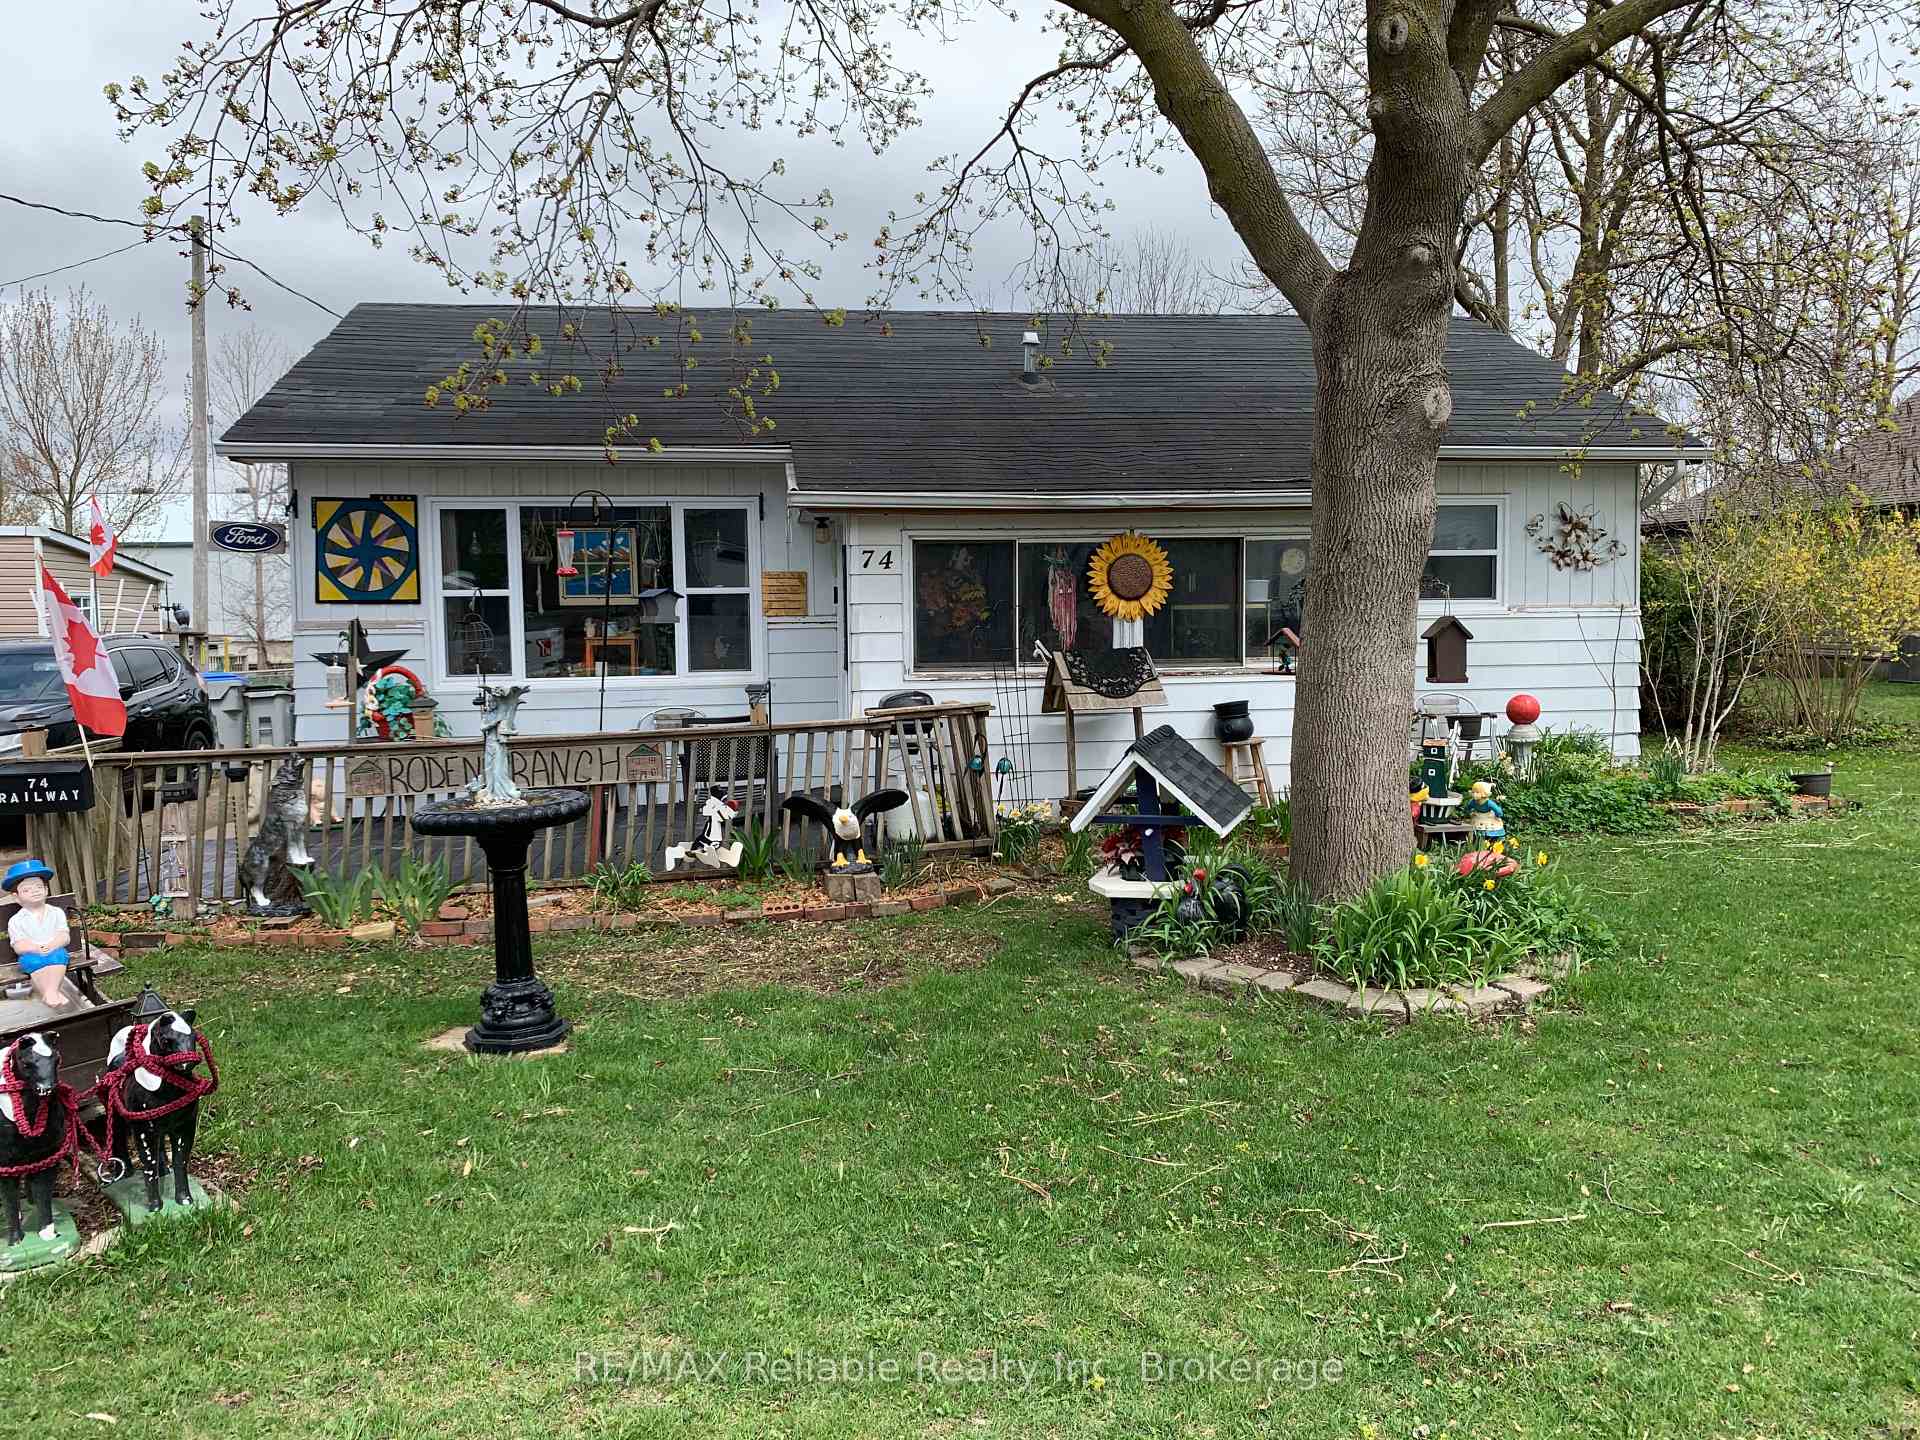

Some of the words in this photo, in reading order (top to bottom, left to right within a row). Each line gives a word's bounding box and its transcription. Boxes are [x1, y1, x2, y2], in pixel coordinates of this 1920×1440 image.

[224, 526, 268, 545] Ford
[862, 550, 894, 570] 74
[510, 746, 621, 788] RANCH
[27, 777, 49, 789] 74
[0, 789, 79, 804] RAILWAY
